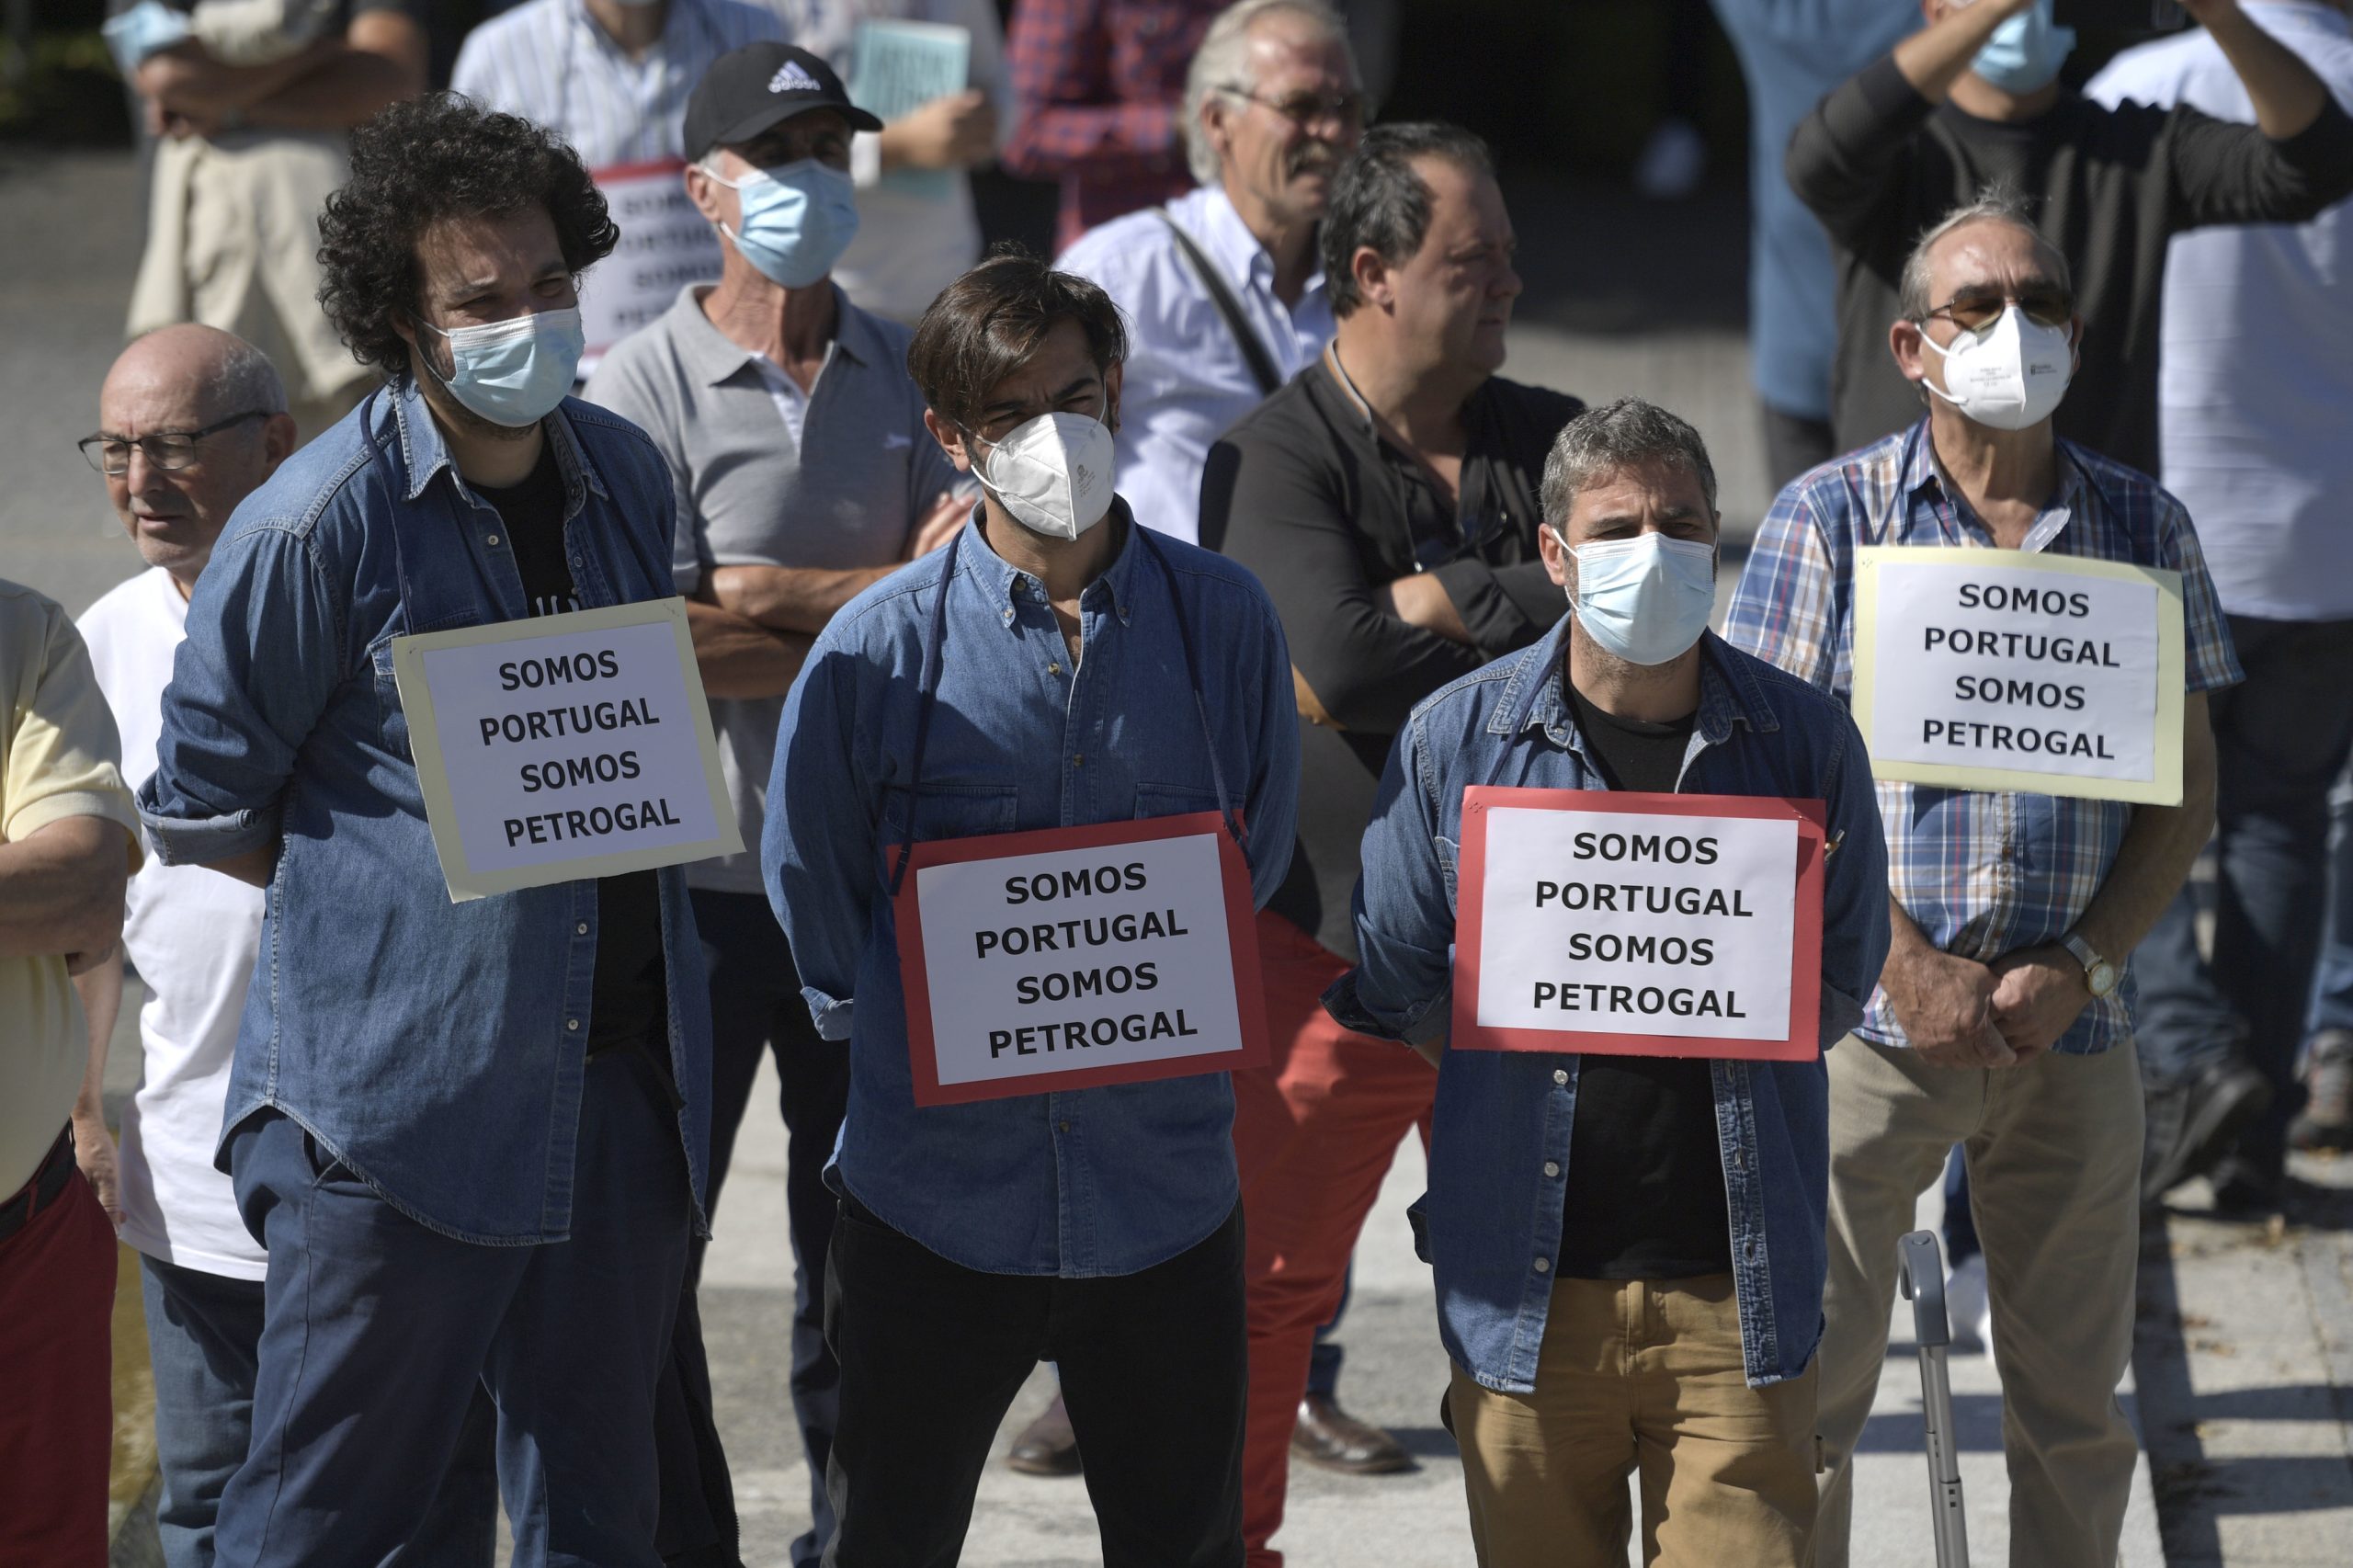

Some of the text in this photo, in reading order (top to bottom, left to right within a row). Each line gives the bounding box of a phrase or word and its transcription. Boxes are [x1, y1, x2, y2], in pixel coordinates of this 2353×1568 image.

[767, 77, 822, 94] adidas
[1959, 584, 2089, 619] SOMOS
[1925, 627, 2120, 668] PORTUGAL
[498, 649, 620, 692] SOMOS
[1955, 676, 2086, 711] SOMOS
[478, 697, 661, 747] PORTUGAL
[1923, 719, 2115, 759] PETROGAL
[519, 750, 641, 793] SOMOS
[503, 798, 682, 848] PETROGAL
[1573, 832, 1718, 865] SOMOS
[1005, 862, 1147, 905] SOMOS
[1536, 881, 1753, 917] PORTUGAL
[974, 908, 1188, 960] PORTUGAL
[1568, 933, 1714, 966] SOMOS
[1016, 961, 1159, 1005] SOMOS
[1533, 982, 1746, 1018] PETROGAL
[988, 1008, 1199, 1059] PETROGAL
